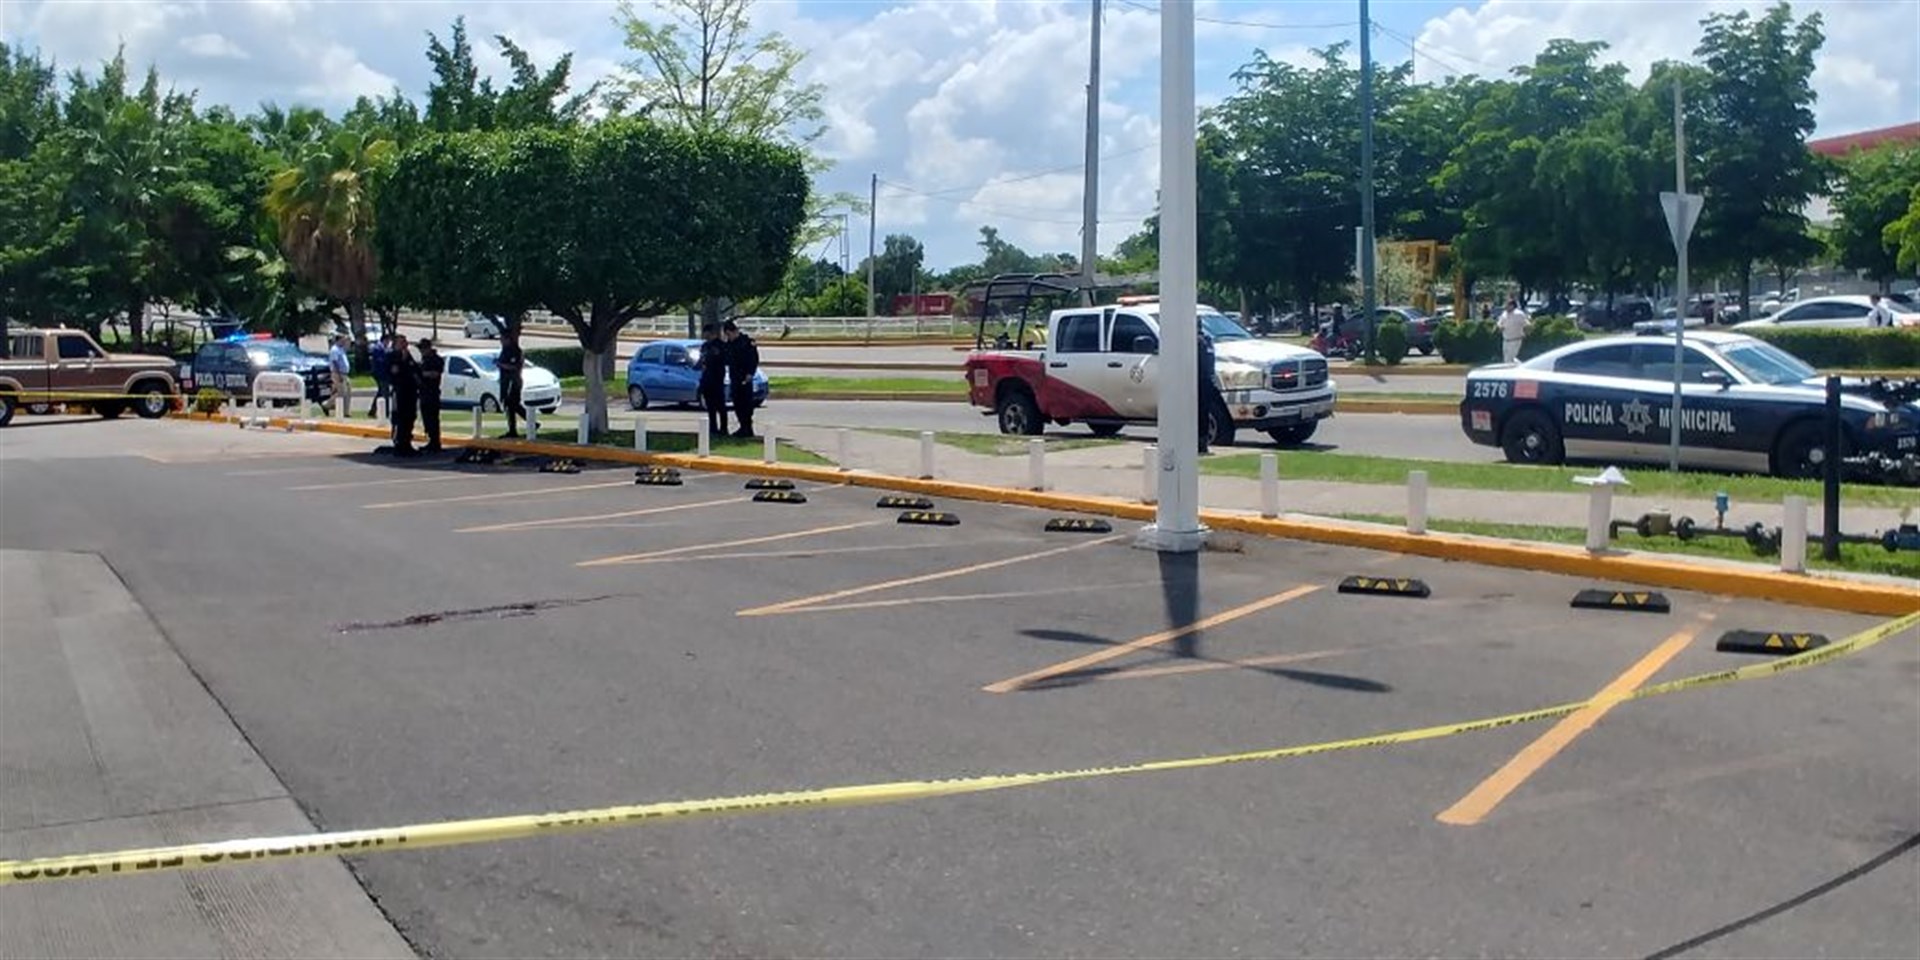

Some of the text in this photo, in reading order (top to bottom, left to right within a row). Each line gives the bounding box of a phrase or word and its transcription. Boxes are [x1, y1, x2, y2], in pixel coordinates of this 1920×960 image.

[1474, 381, 1507, 398] 2576
[1565, 401, 1736, 433] POLICÍA MNICIPAL
